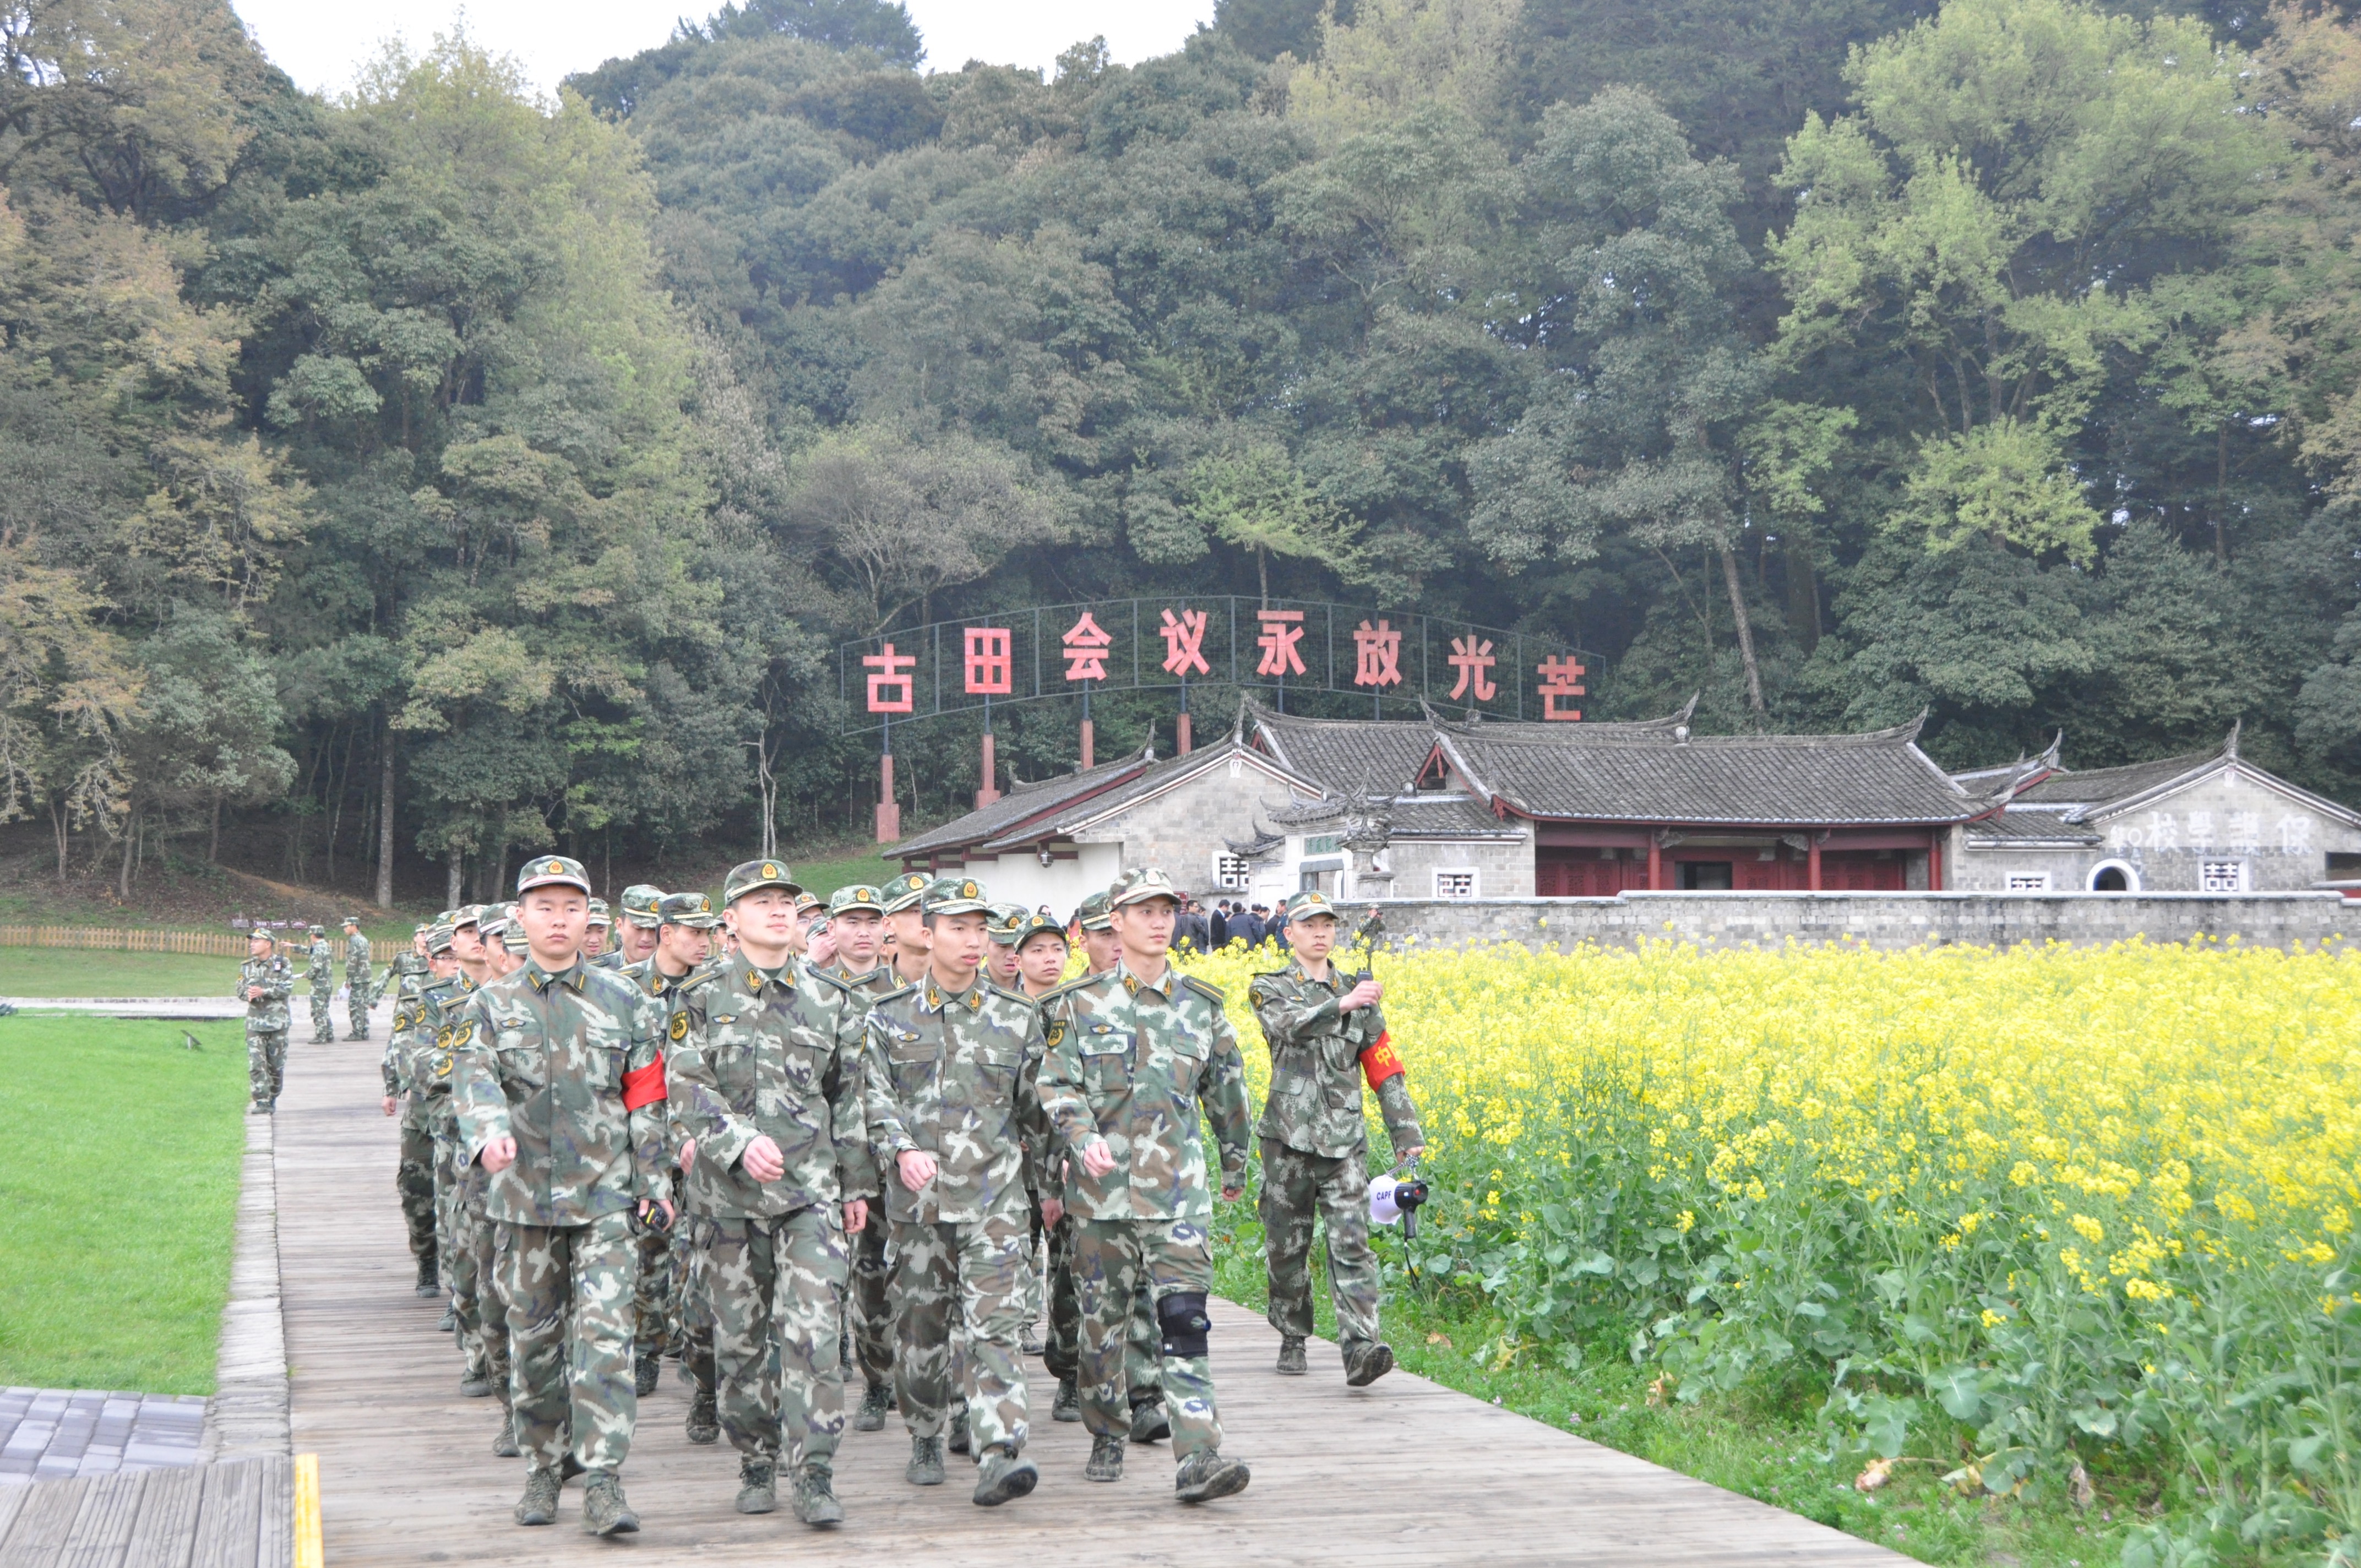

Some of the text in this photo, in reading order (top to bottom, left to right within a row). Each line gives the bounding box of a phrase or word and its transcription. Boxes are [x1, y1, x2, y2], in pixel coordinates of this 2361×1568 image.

[862, 608, 1585, 720] 古田会议永放光芒
[1377, 1190, 1391, 1201] CAPF
